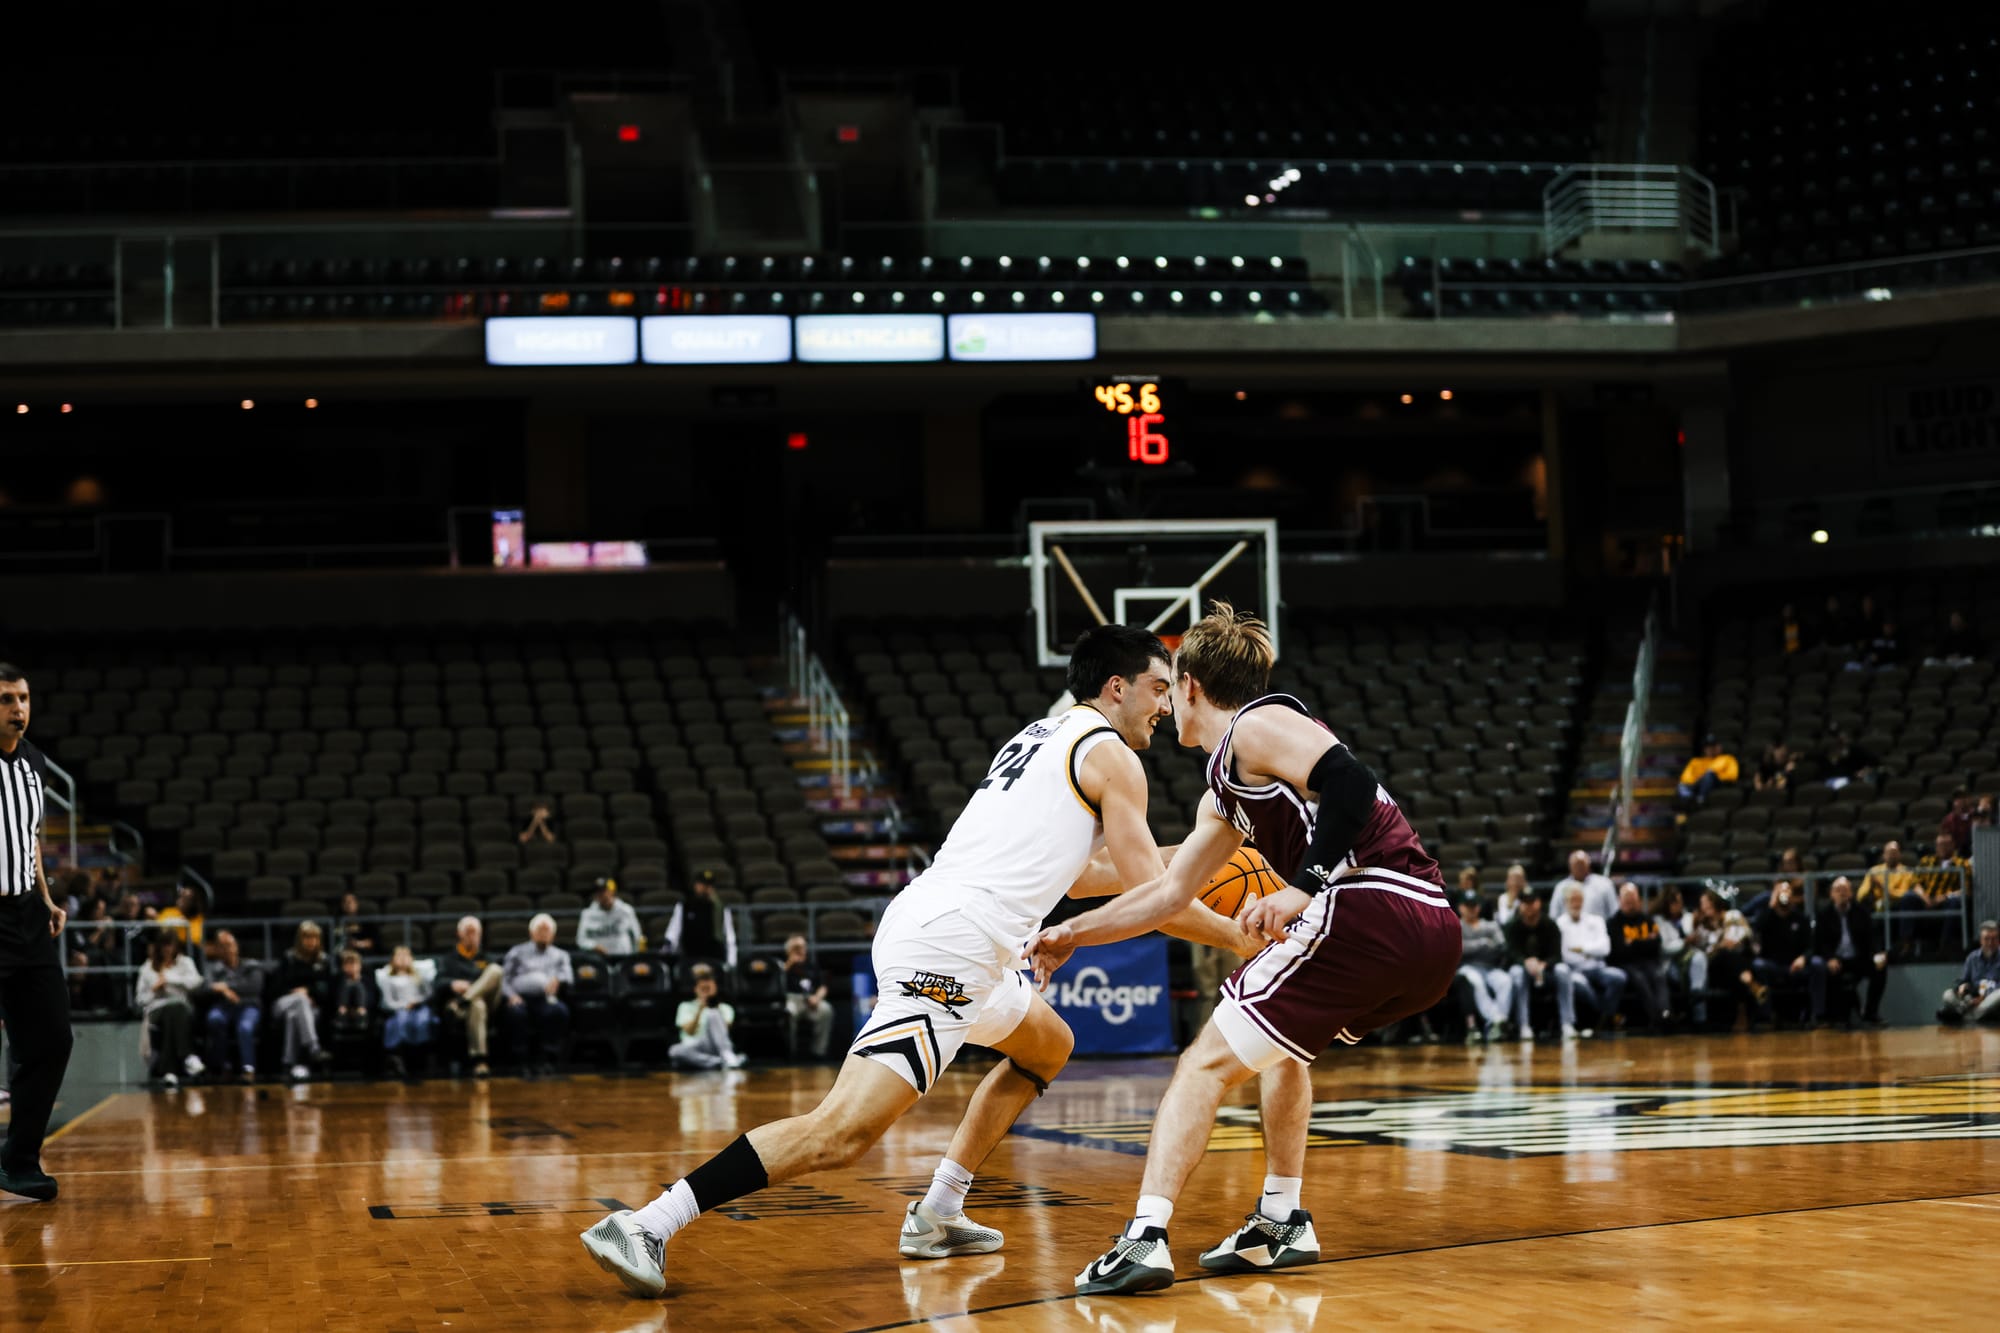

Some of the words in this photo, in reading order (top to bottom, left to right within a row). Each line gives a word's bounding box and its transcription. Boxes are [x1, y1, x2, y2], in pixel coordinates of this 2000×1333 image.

[1095, 383, 1160, 414] 45.6
[1909, 386, 1993, 419] BUD
[1128, 414, 1168, 464] 16
[978, 743, 1044, 791] 24
[1060, 966, 1163, 1025] Kroger
